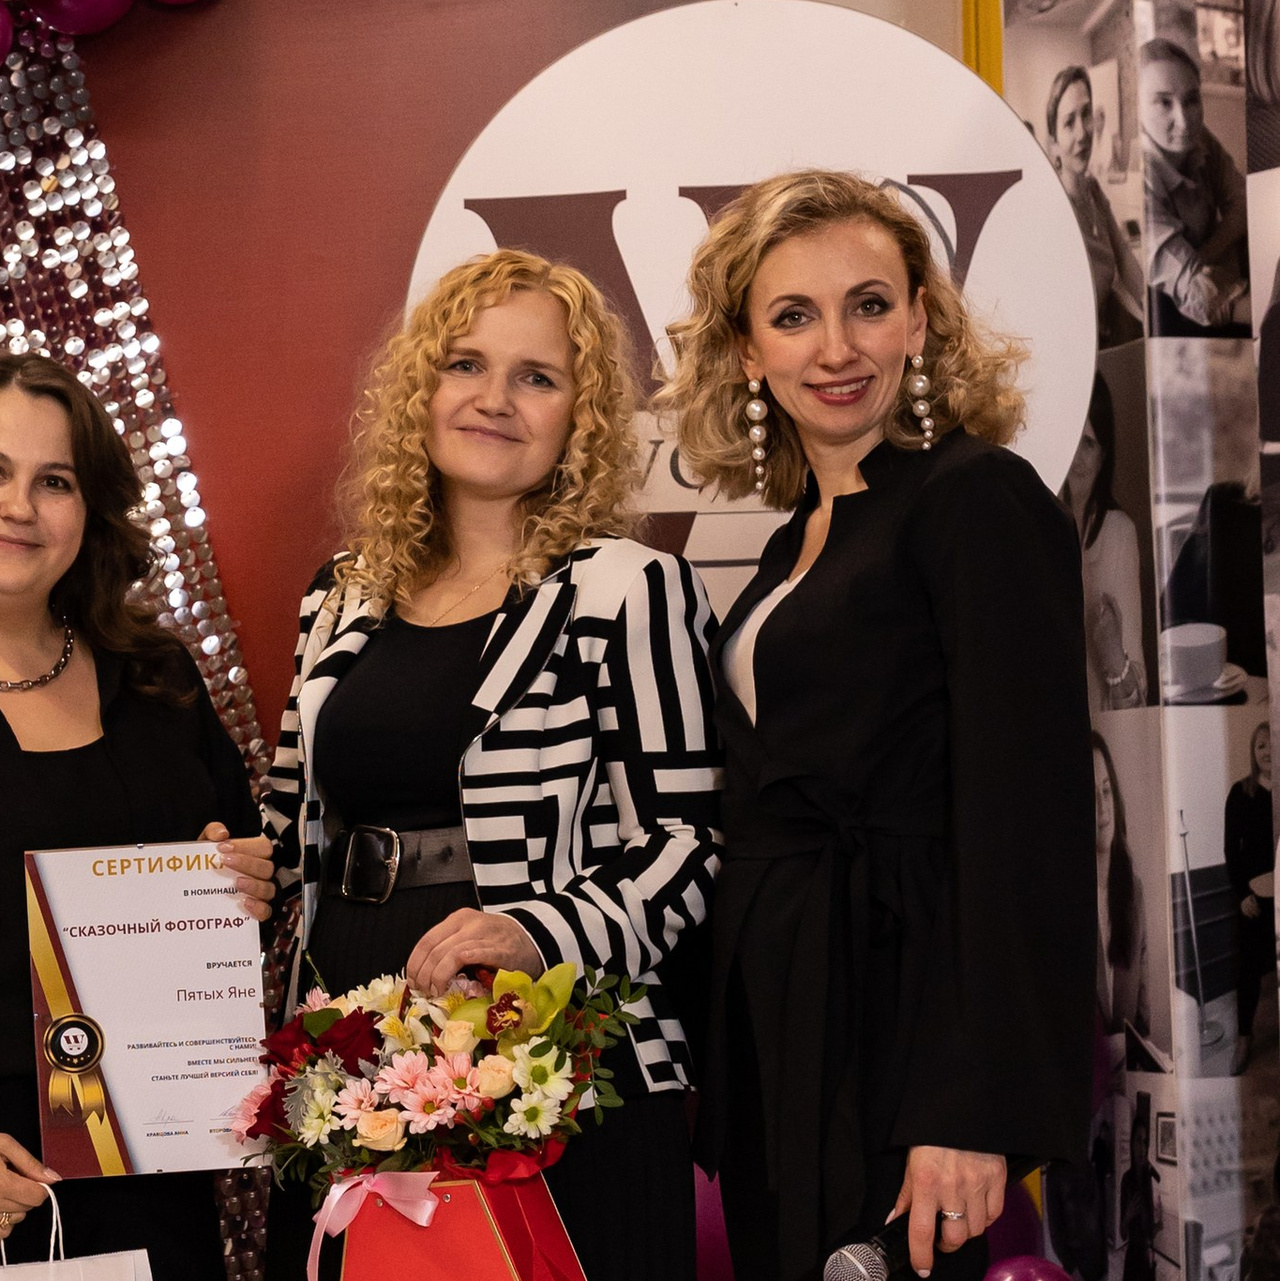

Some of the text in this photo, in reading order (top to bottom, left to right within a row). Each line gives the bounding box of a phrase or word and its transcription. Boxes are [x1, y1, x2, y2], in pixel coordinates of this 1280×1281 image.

[92, 853, 224, 876] СЕРТИФИК
[183, 887, 239, 897] В НОМИНАЦ
[206, 960, 253, 969] ВРУЧАЕТСЯ
[177, 986, 256, 1002] Пятых Яне
[127, 1041, 177, 1050] РАЗВИВАЙТЕСЬ
[185, 1037, 257, 1046] СОВЕРШЕНСТВУЙТЕСЬ
[181, 1071, 209, 1080] ЛУЧШЕЙ
[210, 1069, 240, 1078] ВЕРСИЕЙ
